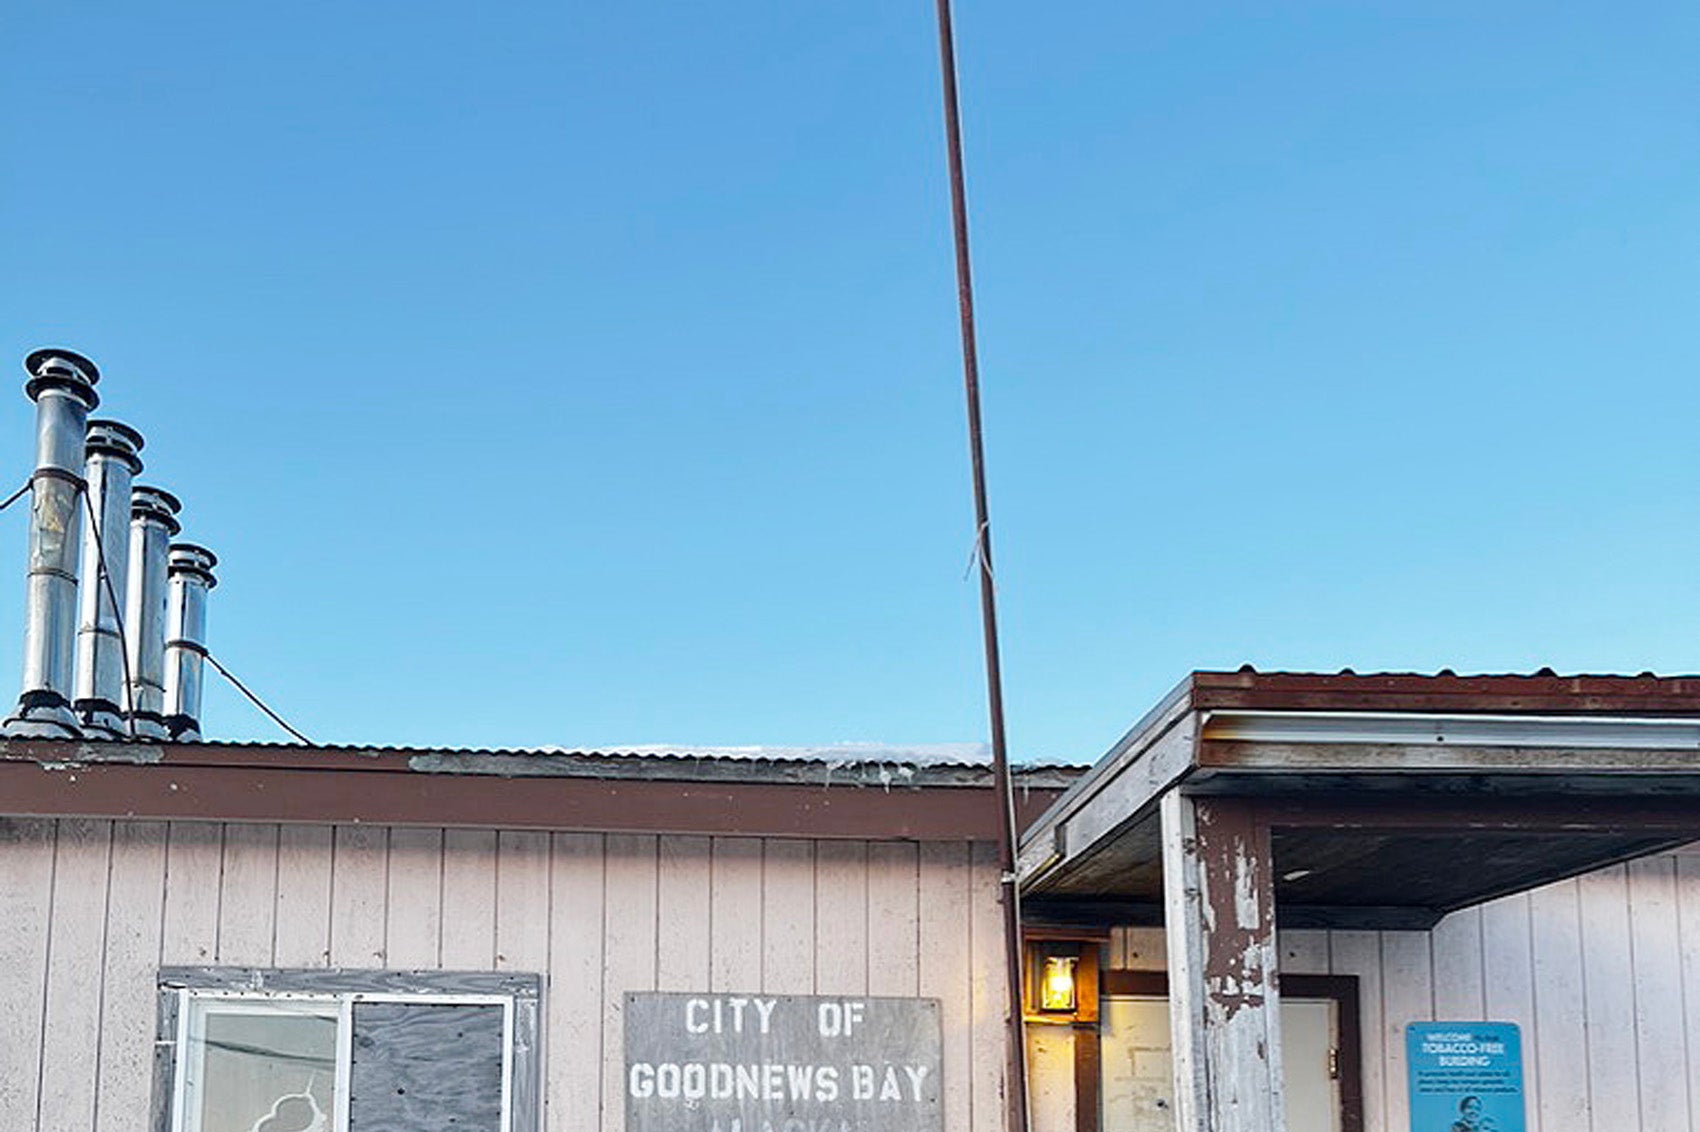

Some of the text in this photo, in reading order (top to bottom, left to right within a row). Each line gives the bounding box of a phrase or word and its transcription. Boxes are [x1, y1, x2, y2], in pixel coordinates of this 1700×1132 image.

[686, 998, 865, 1037] CITY OF
[629, 1062, 928, 1101] GOODNEWS BAY
